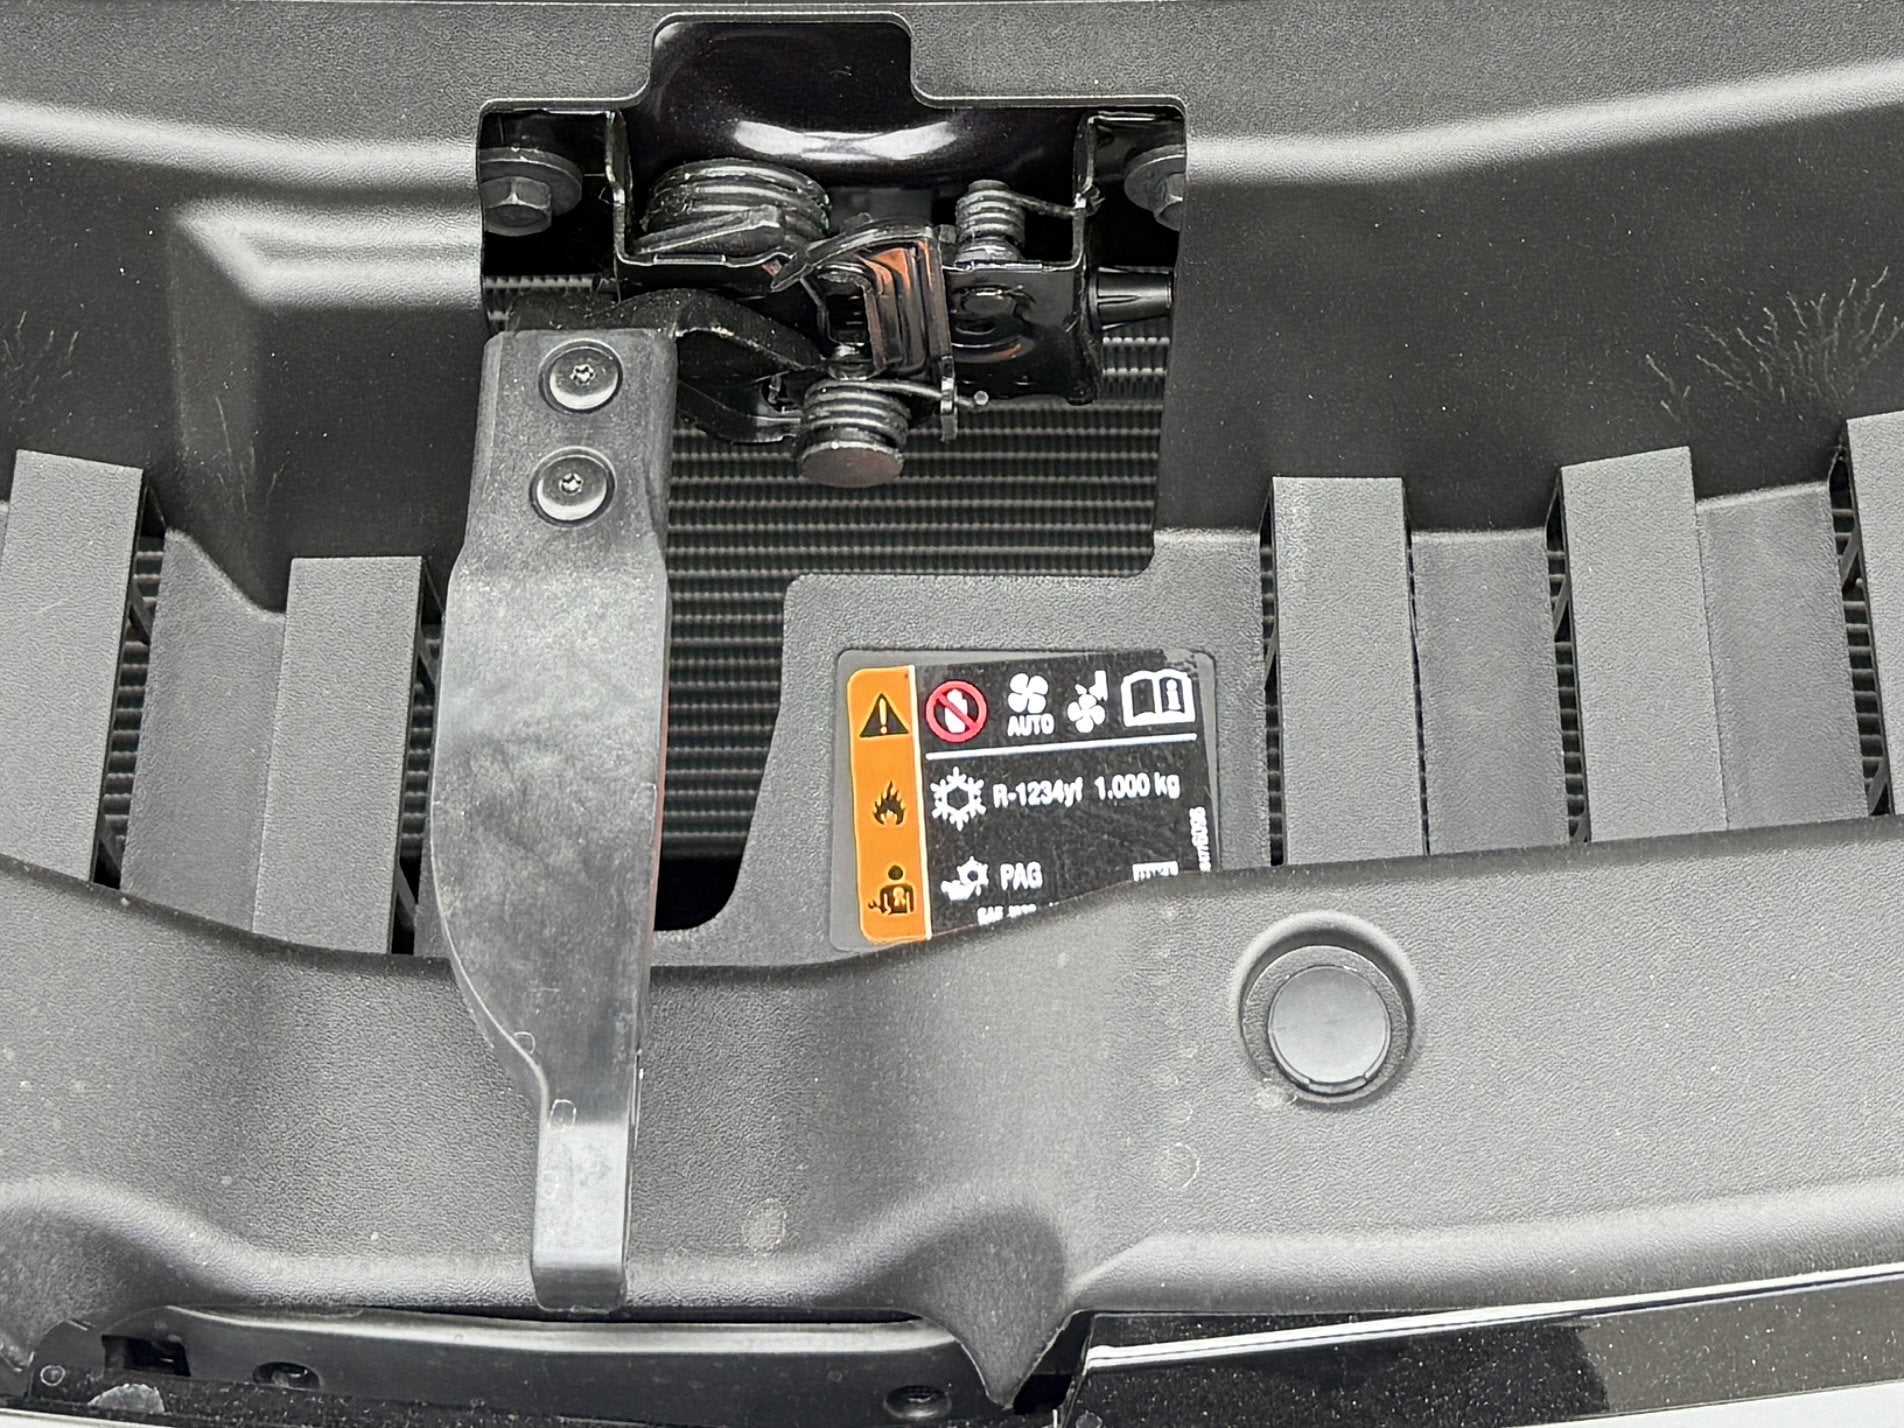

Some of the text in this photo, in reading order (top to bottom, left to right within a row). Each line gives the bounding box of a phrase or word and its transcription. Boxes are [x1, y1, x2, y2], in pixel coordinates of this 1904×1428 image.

[1007, 713, 1055, 737] AUTO
[993, 772, 1181, 808] R-1234yf 1.000 kg
[999, 860, 1044, 890] PAG
